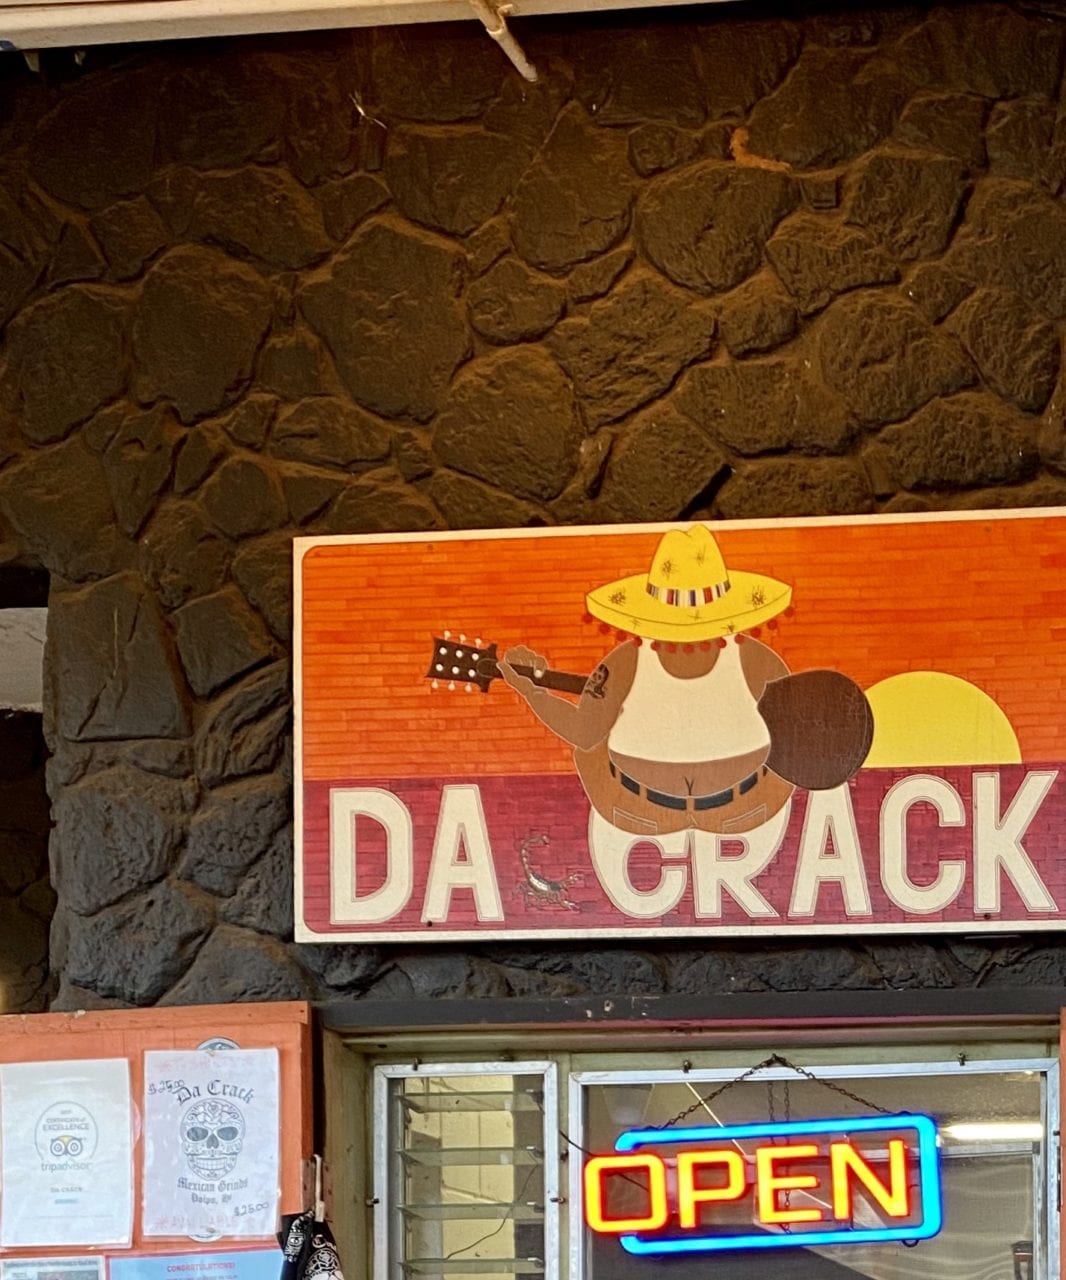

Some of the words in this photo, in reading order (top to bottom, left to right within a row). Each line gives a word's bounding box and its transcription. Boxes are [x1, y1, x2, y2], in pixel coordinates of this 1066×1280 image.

[330, 785, 504, 925] DA
[590, 771, 1058, 918] CRACK
[172, 1085, 200, 1105] Da
[207, 1080, 255, 1104] Crack
[178, 1178, 214, 1192] Mexican
[585, 1139, 908, 1232] OPEN
